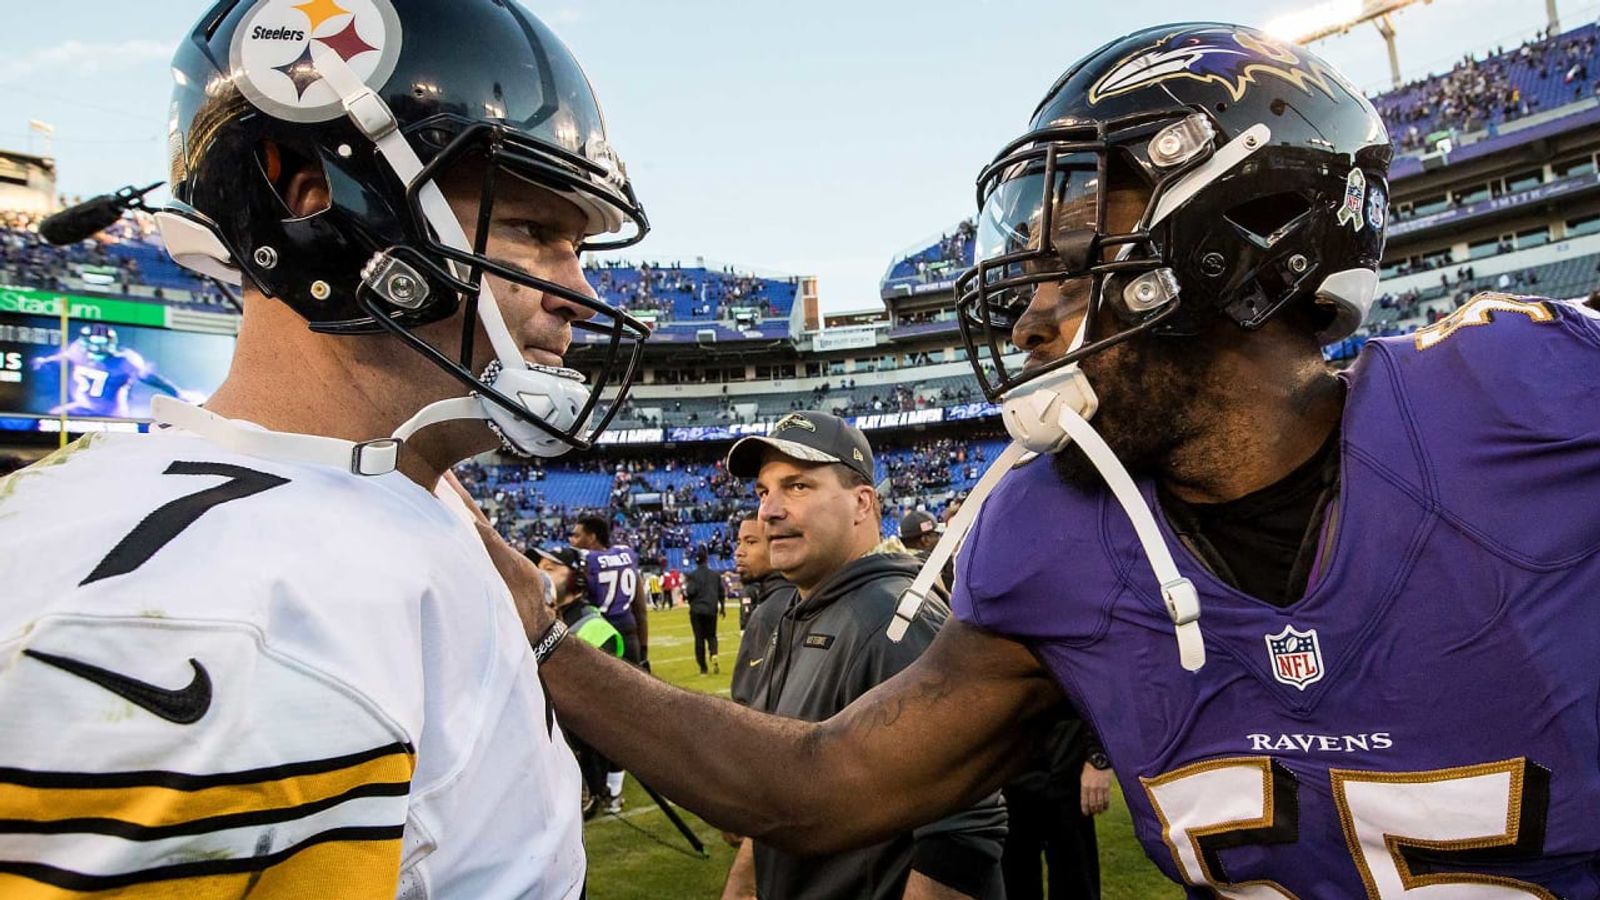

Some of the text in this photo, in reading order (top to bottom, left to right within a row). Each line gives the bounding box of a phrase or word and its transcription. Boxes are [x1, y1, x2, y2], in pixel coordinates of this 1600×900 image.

[252, 25, 304, 41] Steelers
[79, 460, 291, 586] 7
[598, 567, 636, 613] 79
[1277, 653, 1316, 679] NFL
[1246, 732, 1393, 753] RAVENS
